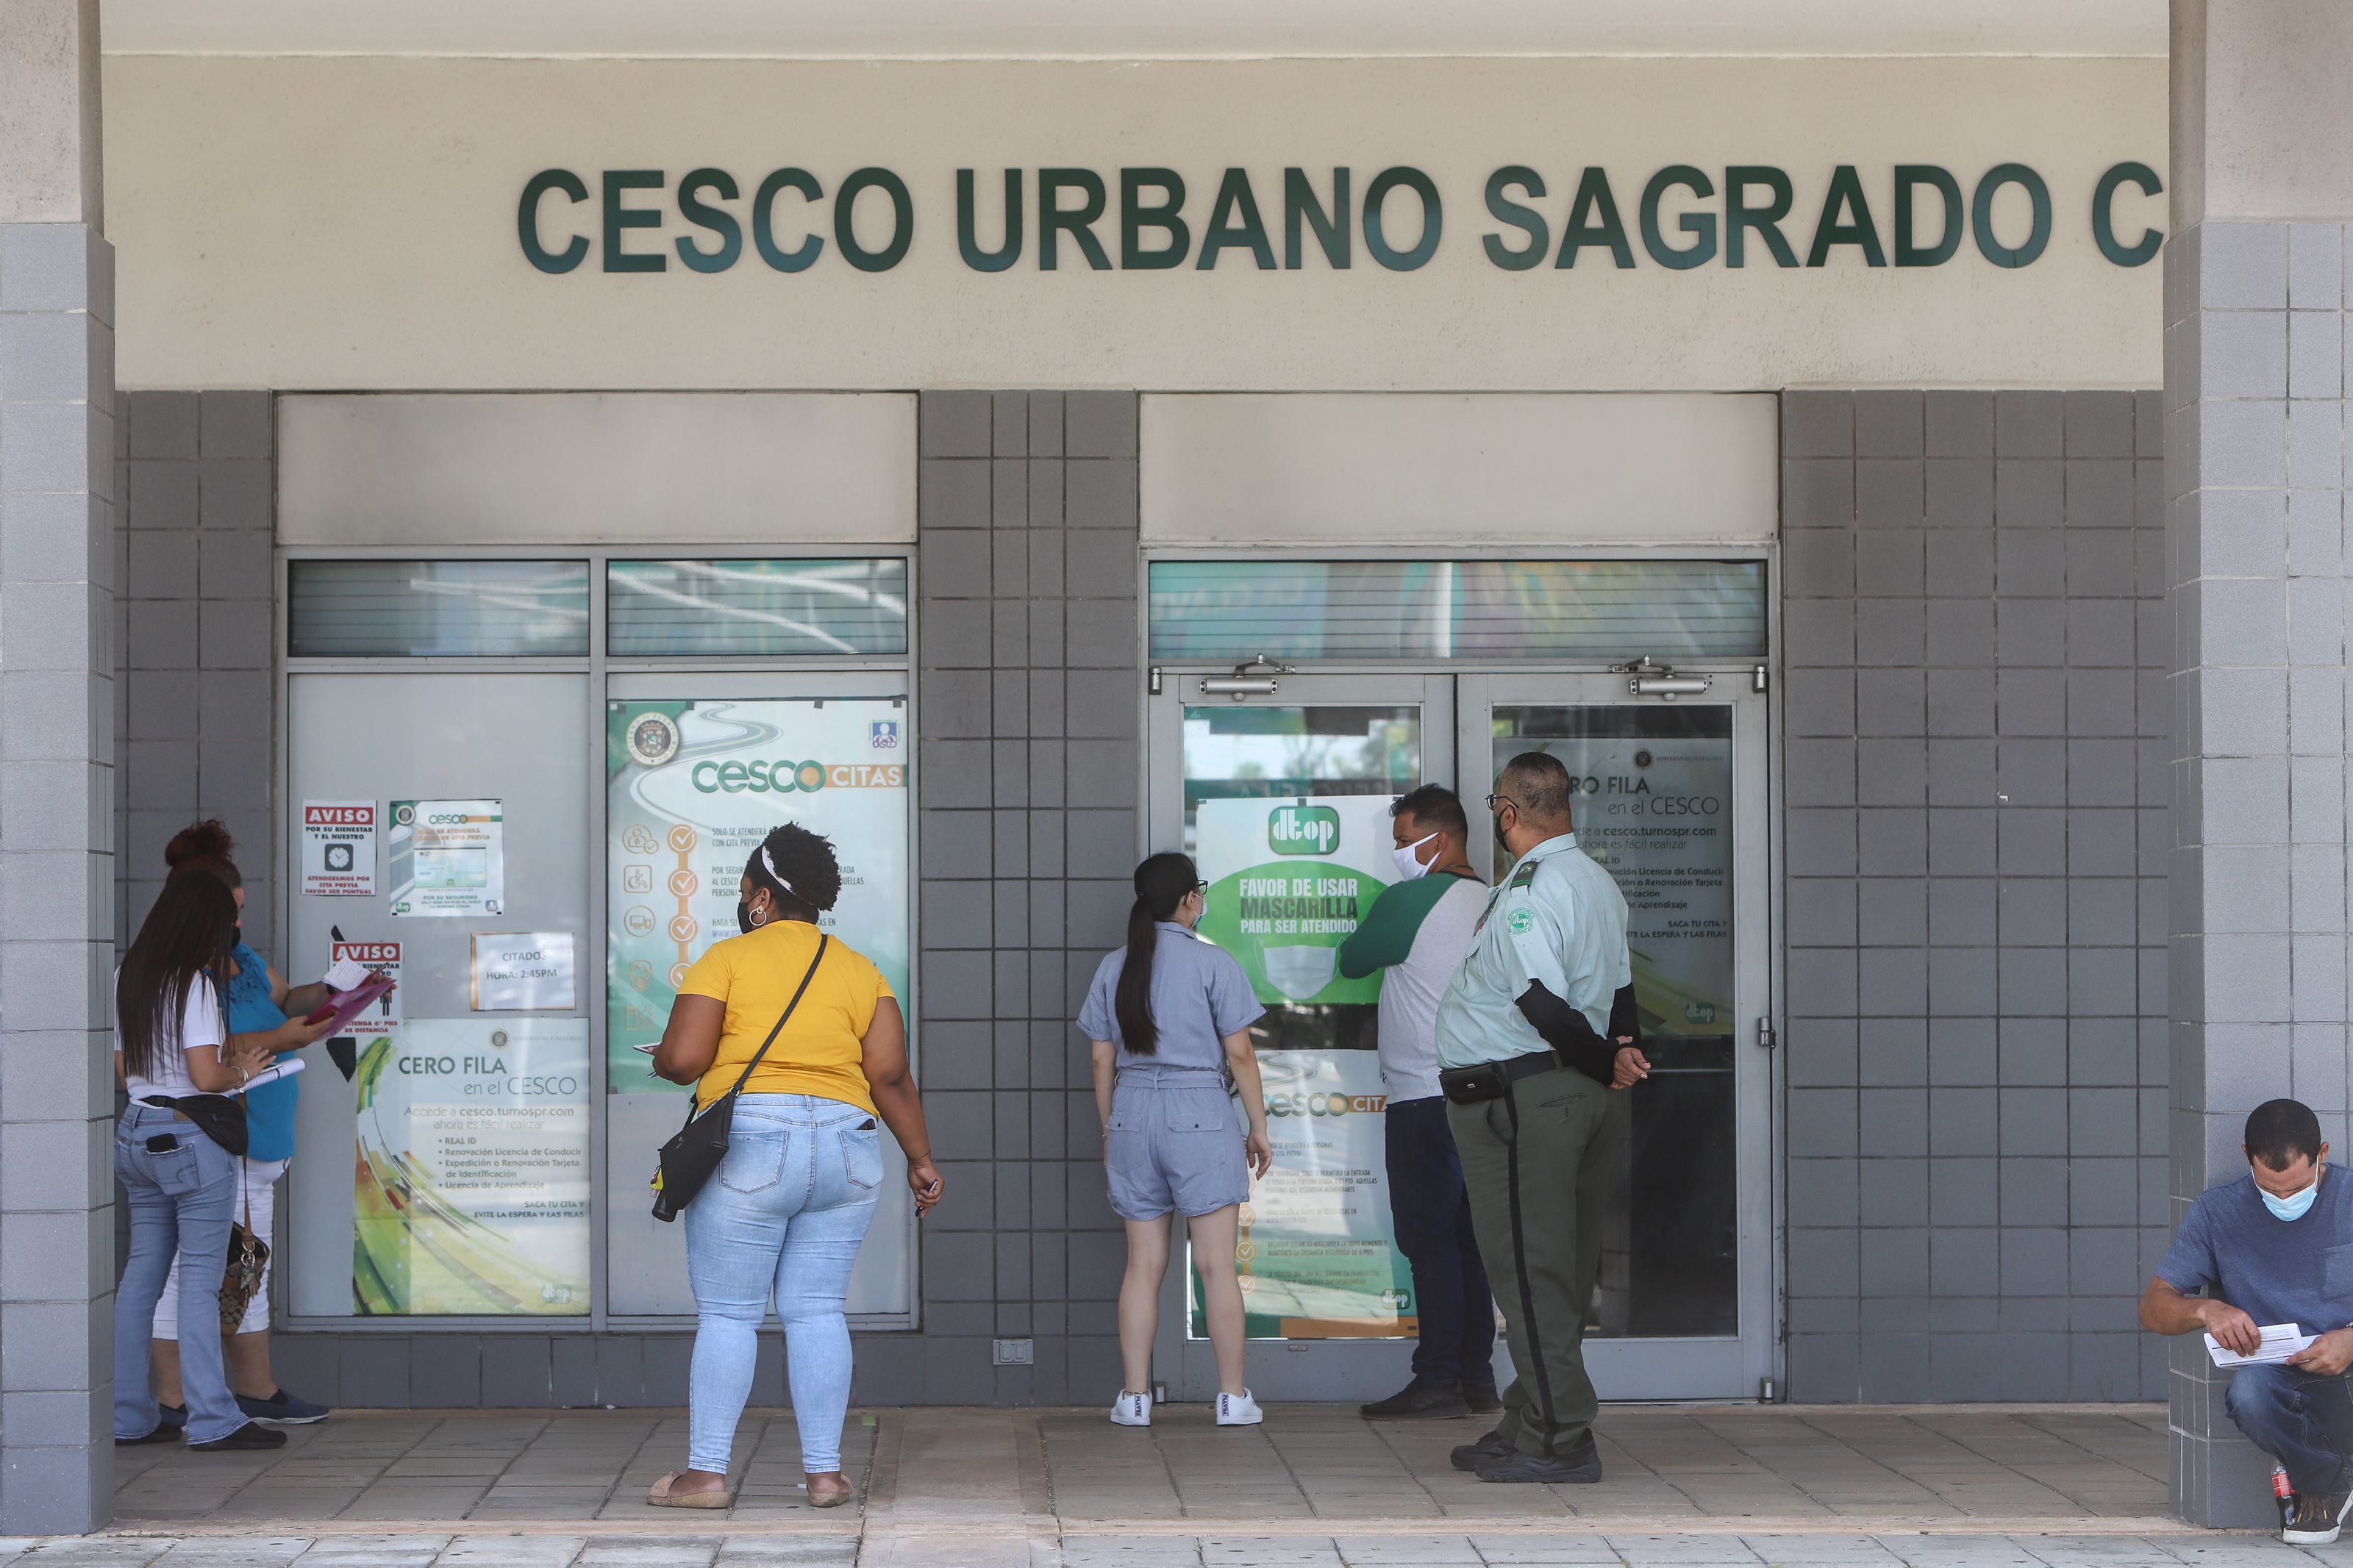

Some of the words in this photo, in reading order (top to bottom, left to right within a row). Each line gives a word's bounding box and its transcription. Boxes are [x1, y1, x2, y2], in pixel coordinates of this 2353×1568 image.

[518, 167, 914, 274] CESCO
[957, 165, 1443, 273] URBANO
[1482, 162, 2052, 271] SAGRADO
[2092, 162, 2164, 268] C
[692, 760, 826, 793] cesco
[832, 766, 901, 786] CITAS
[1570, 776, 1599, 794] RO
[1608, 776, 1651, 794] FILA
[1608, 803, 1626, 815] en
[1631, 801, 1644, 815] el
[1651, 797, 1719, 815] CESCO
[309, 809, 370, 823] AVISO
[429, 815, 468, 824] cesco
[713, 828, 727, 836] SOLO
[738, 826, 767, 836] ATENDERÁ
[1273, 809, 1335, 851] dtop
[1604, 826, 1716, 837] cesco.turnospr.com
[1611, 840, 1622, 849] es
[1626, 838, 1646, 849] fácil
[1650, 838, 1688, 849] realizar
[1240, 878, 1287, 897] FAVOR
[1293, 878, 1312, 896] DE
[1317, 878, 1358, 896] USAR
[1695, 879, 1722, 887] Tarjeta
[1240, 898, 1358, 919] MASCARILLA
[1638, 901, 1688, 909] Aprendizaje
[1240, 920, 1271, 934] PARA
[1275, 920, 1297, 934] SER
[1301, 920, 1357, 934] ATENDIDO
[1513, 915, 1529, 927] dtop
[337, 945, 396, 959] AVISO
[502, 952, 546, 961] CITADOS
[487, 971, 518, 980] HORA:
[521, 969, 557, 978] 2:45PM
[1687, 1003, 1713, 1023] dtop
[399, 1056, 455, 1075] CERO
[463, 1057, 507, 1075] FILA
[464, 1084, 482, 1095] en
[488, 1081, 501, 1095] el
[507, 1077, 576, 1095] CESCO
[404, 1106, 447, 1117] Accede
[450, 1108, 457, 1117] a
[460, 1106, 574, 1118] cesco.turnospr.com
[434, 1120, 463, 1129] ahora
[467, 1121, 479, 1129] es
[482, 1119, 503, 1129] fácil
[506, 1120, 544, 1129] realizar
[445, 1159, 491, 1168] Expedición
[552, 1159, 579, 1167] Tarjeta
[494, 1181, 545, 1190] Aprendizaje
[1382, 1290, 1407, 1307] dtop
